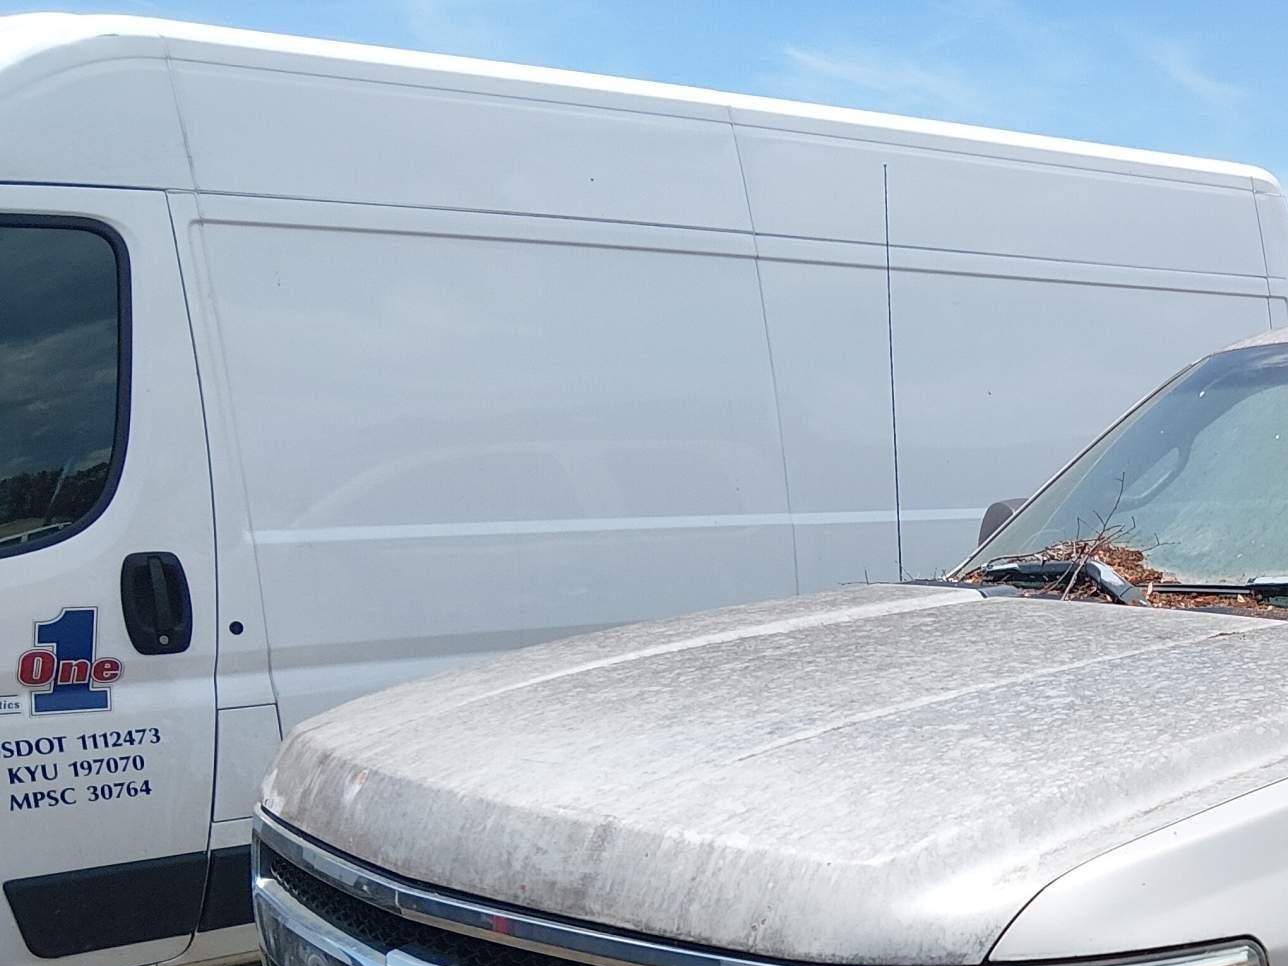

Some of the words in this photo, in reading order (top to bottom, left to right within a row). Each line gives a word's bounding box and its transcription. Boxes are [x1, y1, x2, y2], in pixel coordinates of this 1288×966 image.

[17, 648, 122, 687] One
[77, 728, 161, 751] 1112473
[7, 763, 58, 785] KYU
[68, 755, 145, 777] 197070
[10, 788, 77, 811] MPSC
[87, 780, 152, 802] 30764
